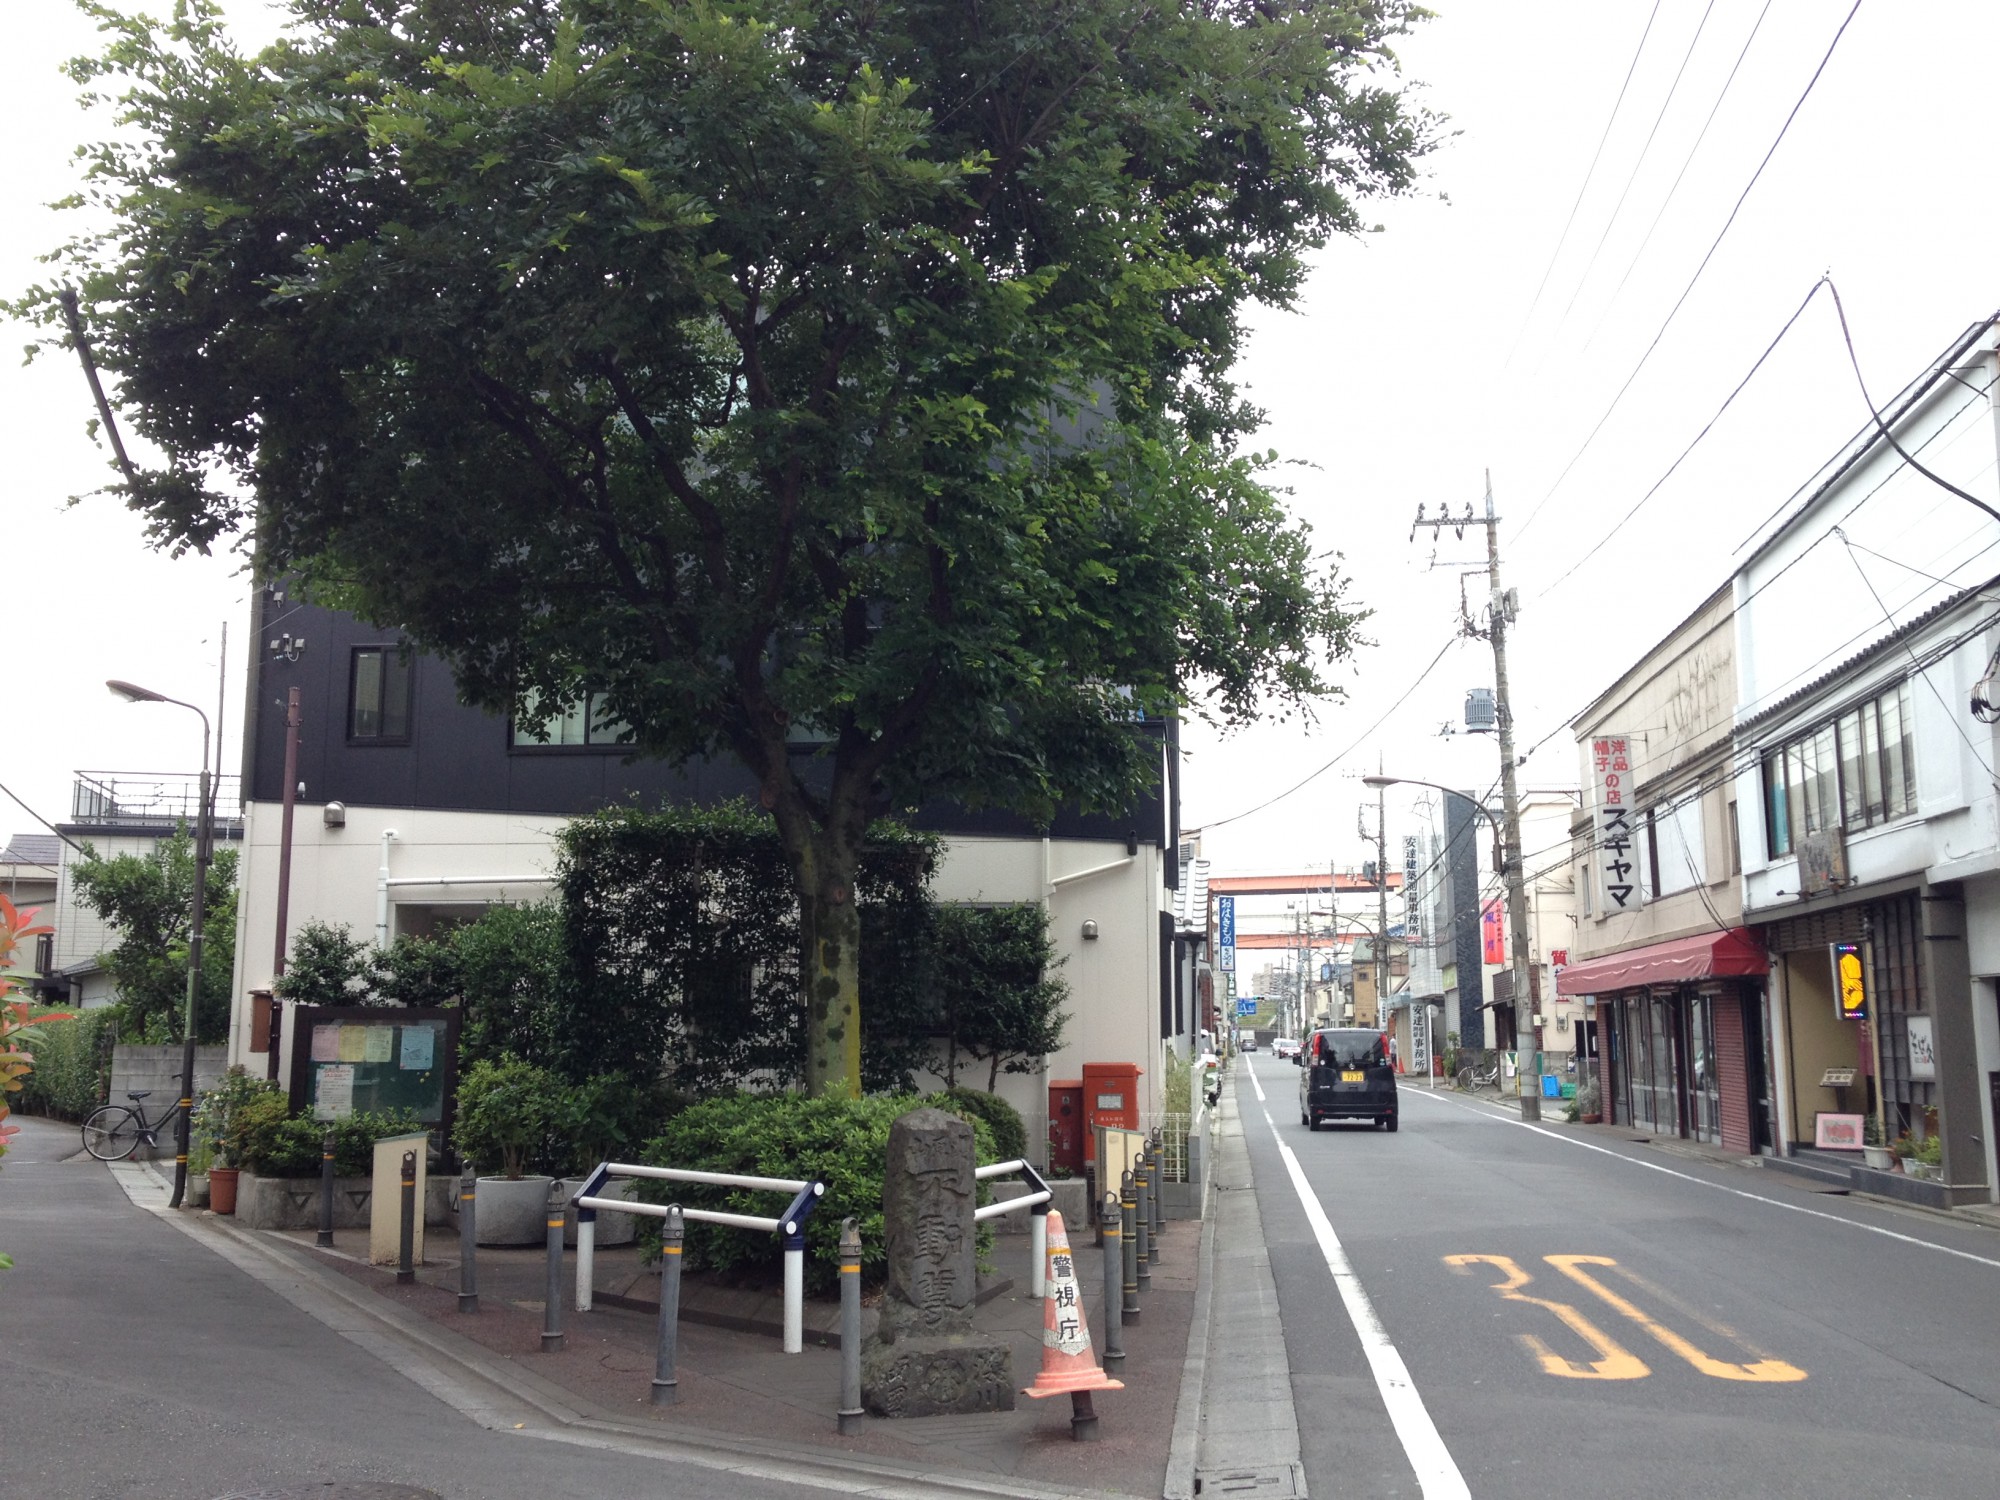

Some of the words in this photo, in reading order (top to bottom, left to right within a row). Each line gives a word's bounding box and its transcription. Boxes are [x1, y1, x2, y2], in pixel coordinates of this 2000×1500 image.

[1594, 739, 1611, 773] 帽子
[1611, 739, 1629, 772] 洋品
[1605, 773, 1622, 805] の店
[1405, 837, 1420, 936] 安達建築測量事務所
[1221, 898, 1232, 945] おはきもの
[1484, 911, 1497, 951] 風月
[1551, 950, 1568, 966] 質
[1052, 1255, 1079, 1341] 警視庁
[1442, 1254, 1809, 1382] 30
